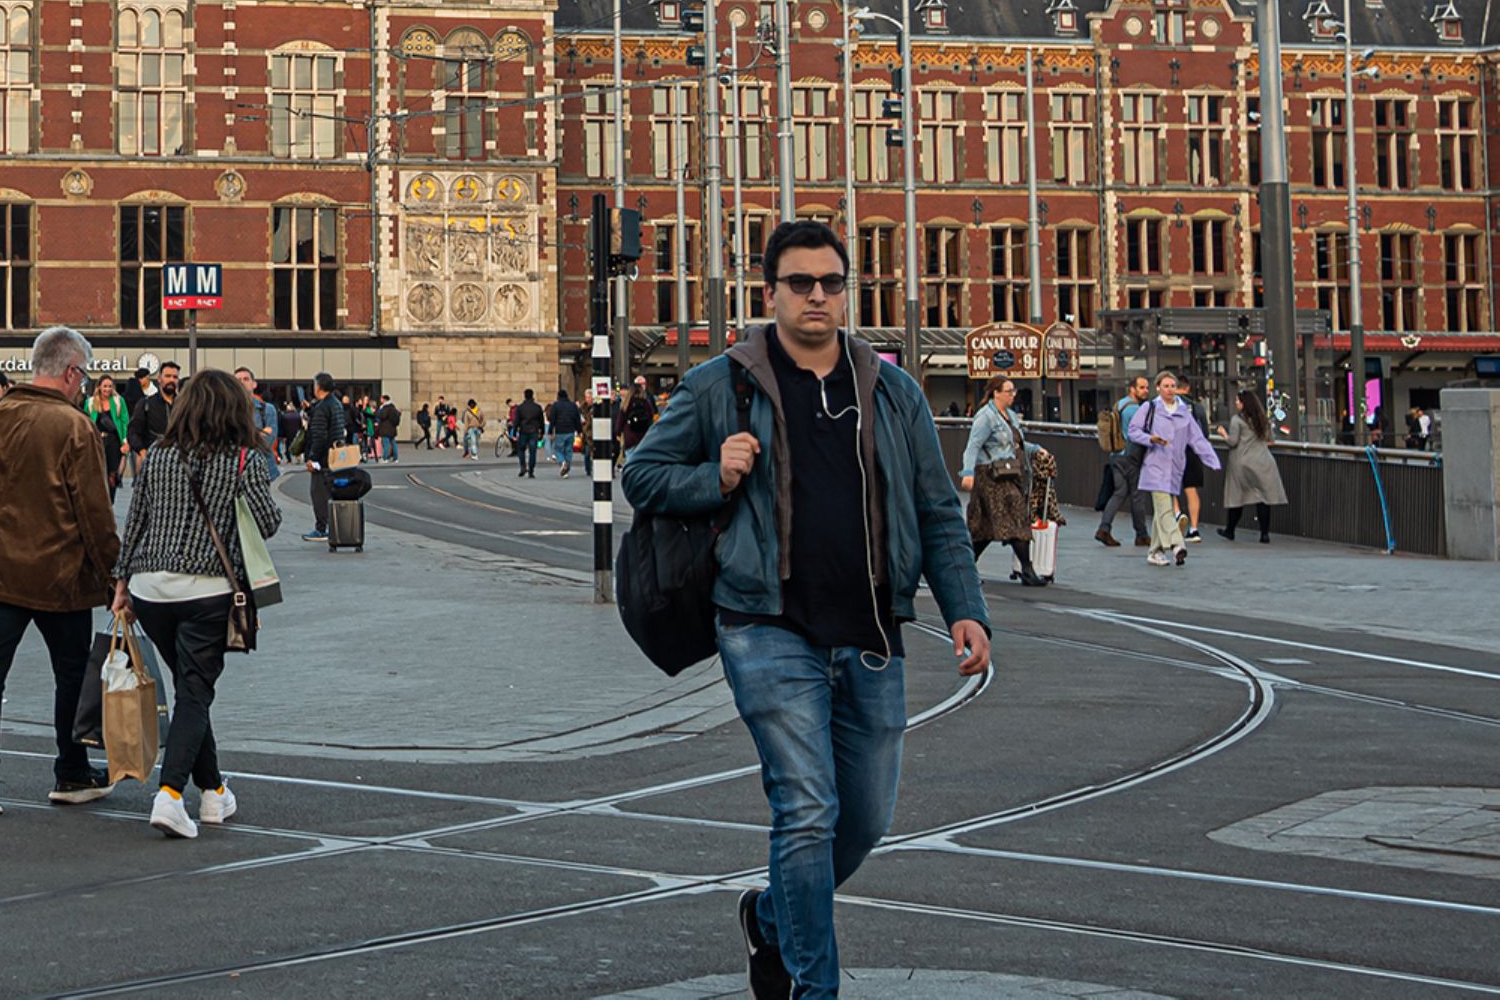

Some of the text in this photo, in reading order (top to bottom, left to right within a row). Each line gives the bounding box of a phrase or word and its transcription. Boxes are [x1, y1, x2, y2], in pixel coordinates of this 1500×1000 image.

[168, 266, 217, 294] M M
[971, 336, 1038, 349] CANAL TOUR
